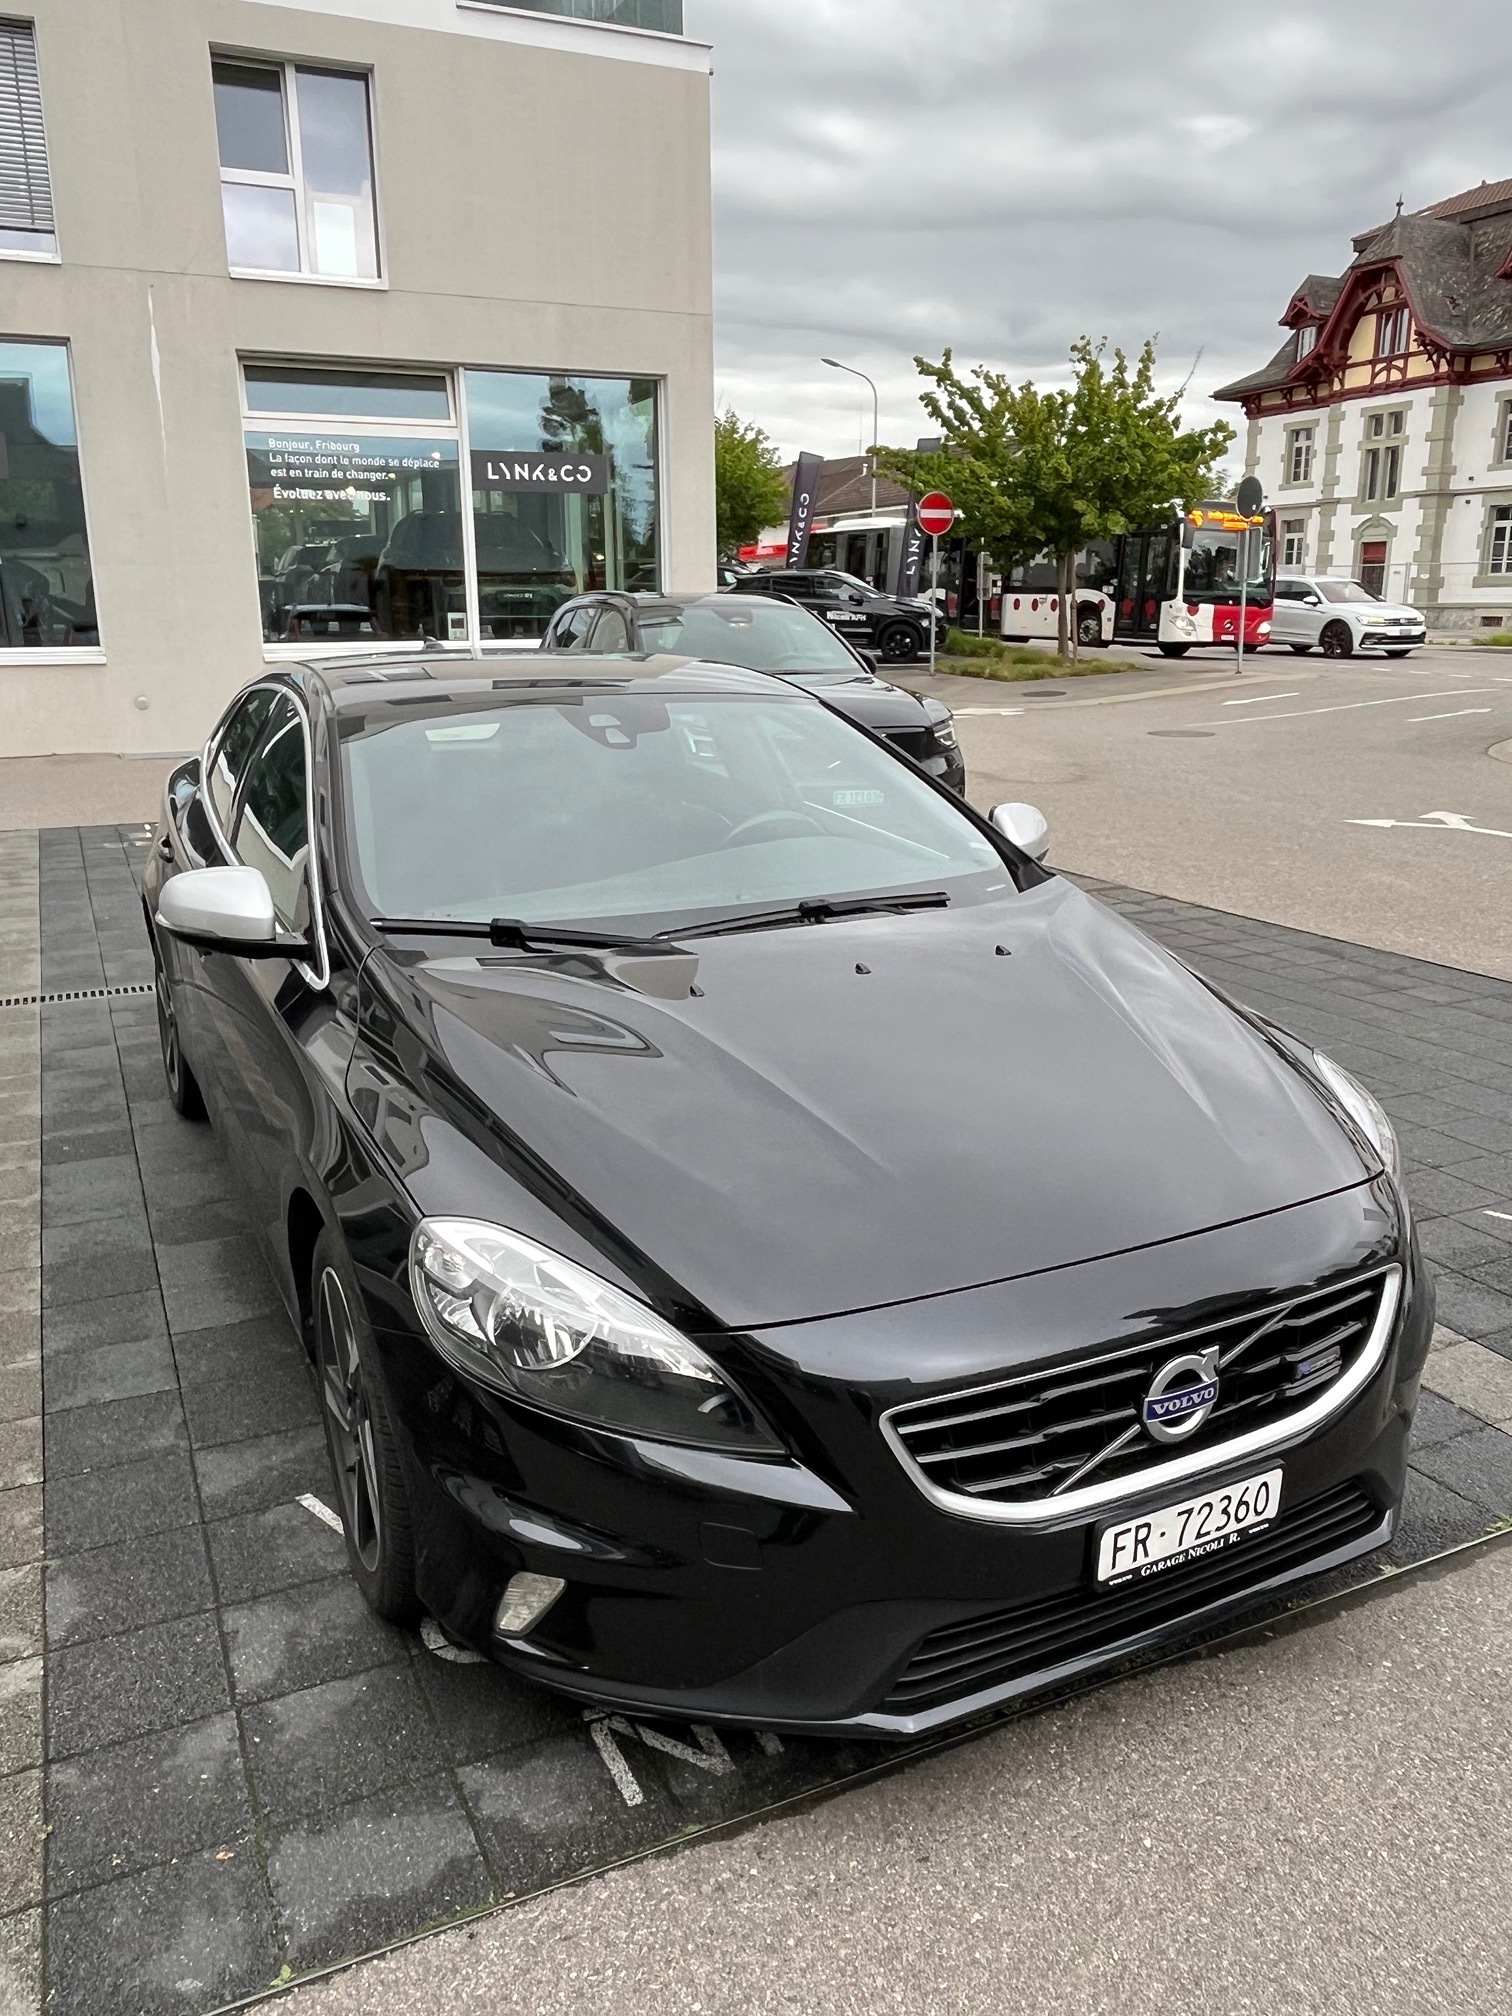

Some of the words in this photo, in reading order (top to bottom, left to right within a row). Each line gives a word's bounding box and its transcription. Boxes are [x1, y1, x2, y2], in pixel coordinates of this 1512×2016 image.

[268, 438, 313, 451] Bonjour,
[315, 440, 360, 453] Fribourg
[269, 453, 282, 463] La
[284, 453, 313, 466] façon
[315, 455, 338, 465] dont
[340, 456, 349, 465] le
[352, 456, 386, 467] monde
[388, 458, 400, 467] se
[402, 457, 440, 469] déplace
[270, 468, 287, 477] est
[289, 470, 303, 478] en
[304, 468, 329, 478] train
[331, 469, 344, 479] de
[345, 469, 388, 481] changer.
[273, 483, 323, 499] Évoluez
[324, 488, 354, 500] avec
[355, 489, 391, 501] nous.
[789, 493, 810, 571] YNK&CO
[1151, 1387, 1215, 1415] VOLVO
[1140, 1552, 1186, 1577] GARAGE
[1187, 1538, 1225, 1561] NICOLI
[1228, 1532, 1241, 1544] R.
